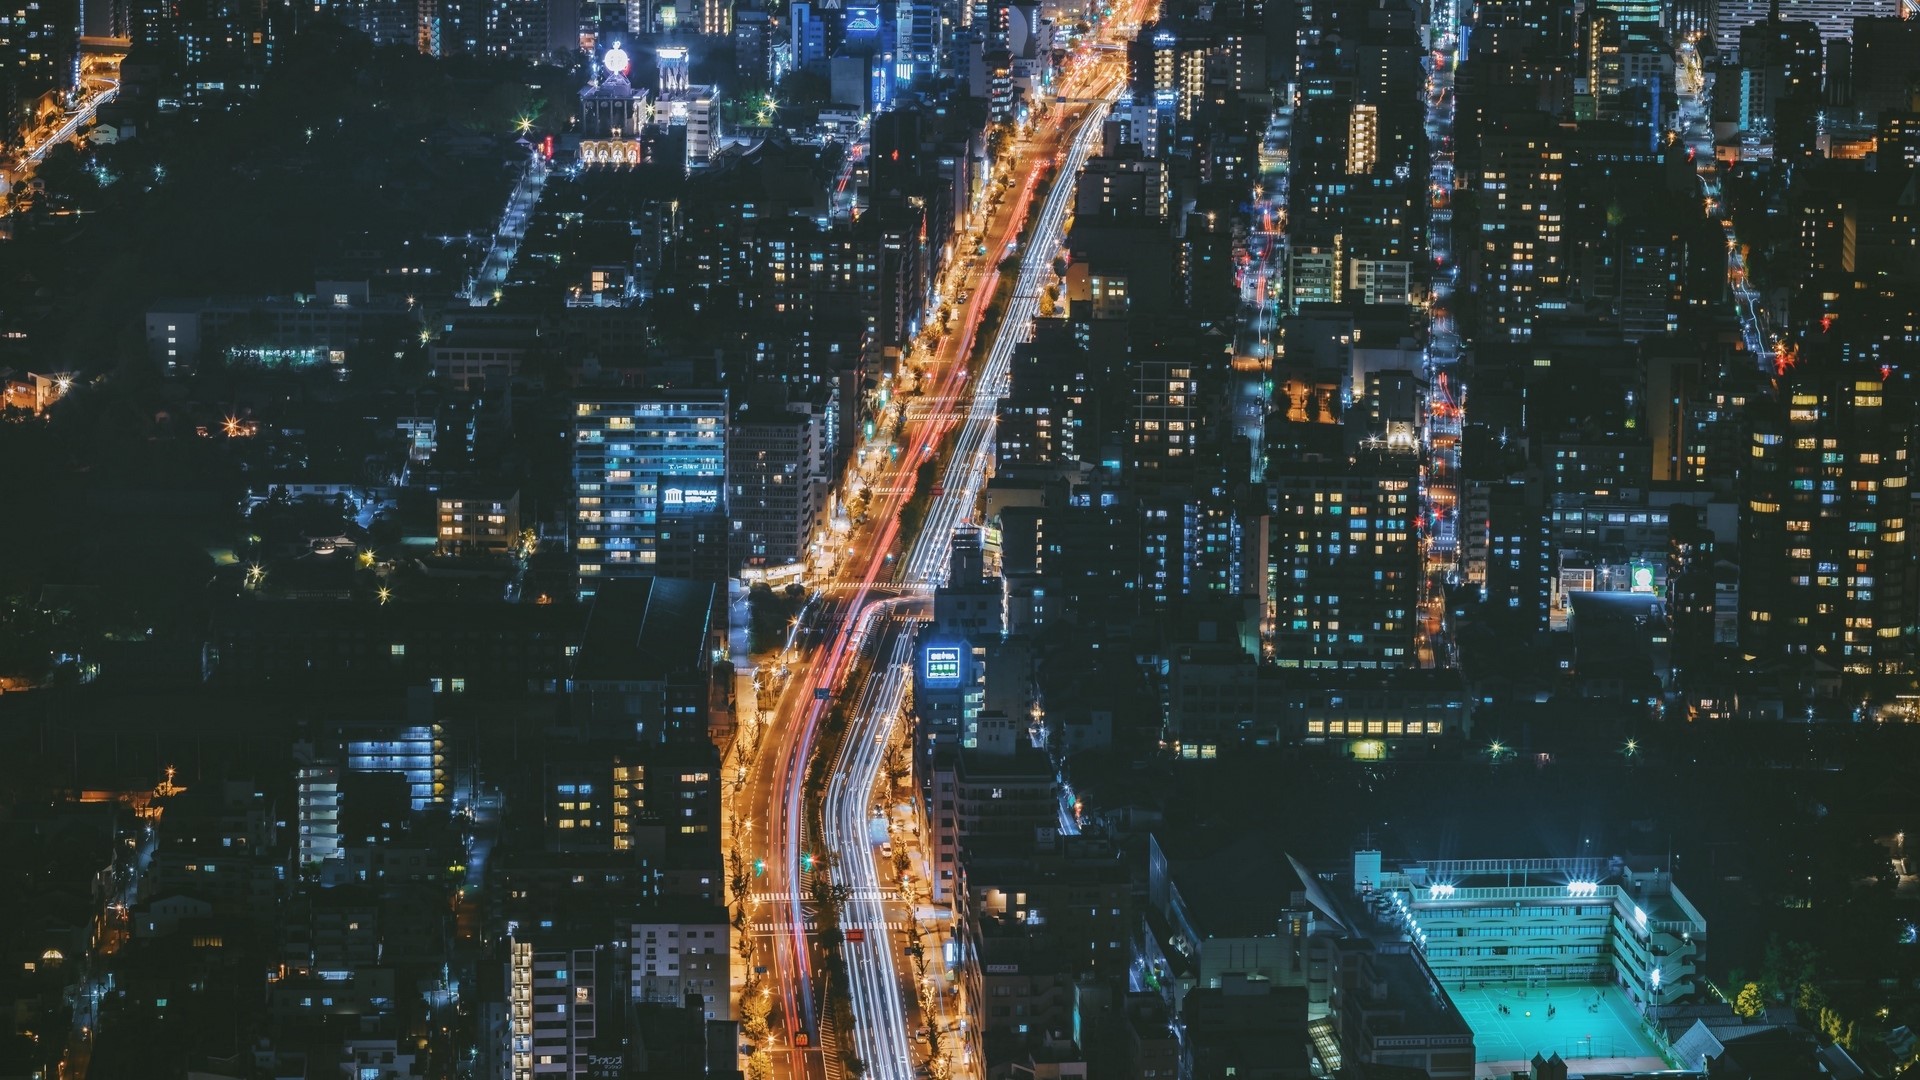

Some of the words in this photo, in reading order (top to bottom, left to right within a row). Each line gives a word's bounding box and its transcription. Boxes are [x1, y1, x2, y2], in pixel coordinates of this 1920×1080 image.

[589, 1055, 623, 1065] ライオンズ
